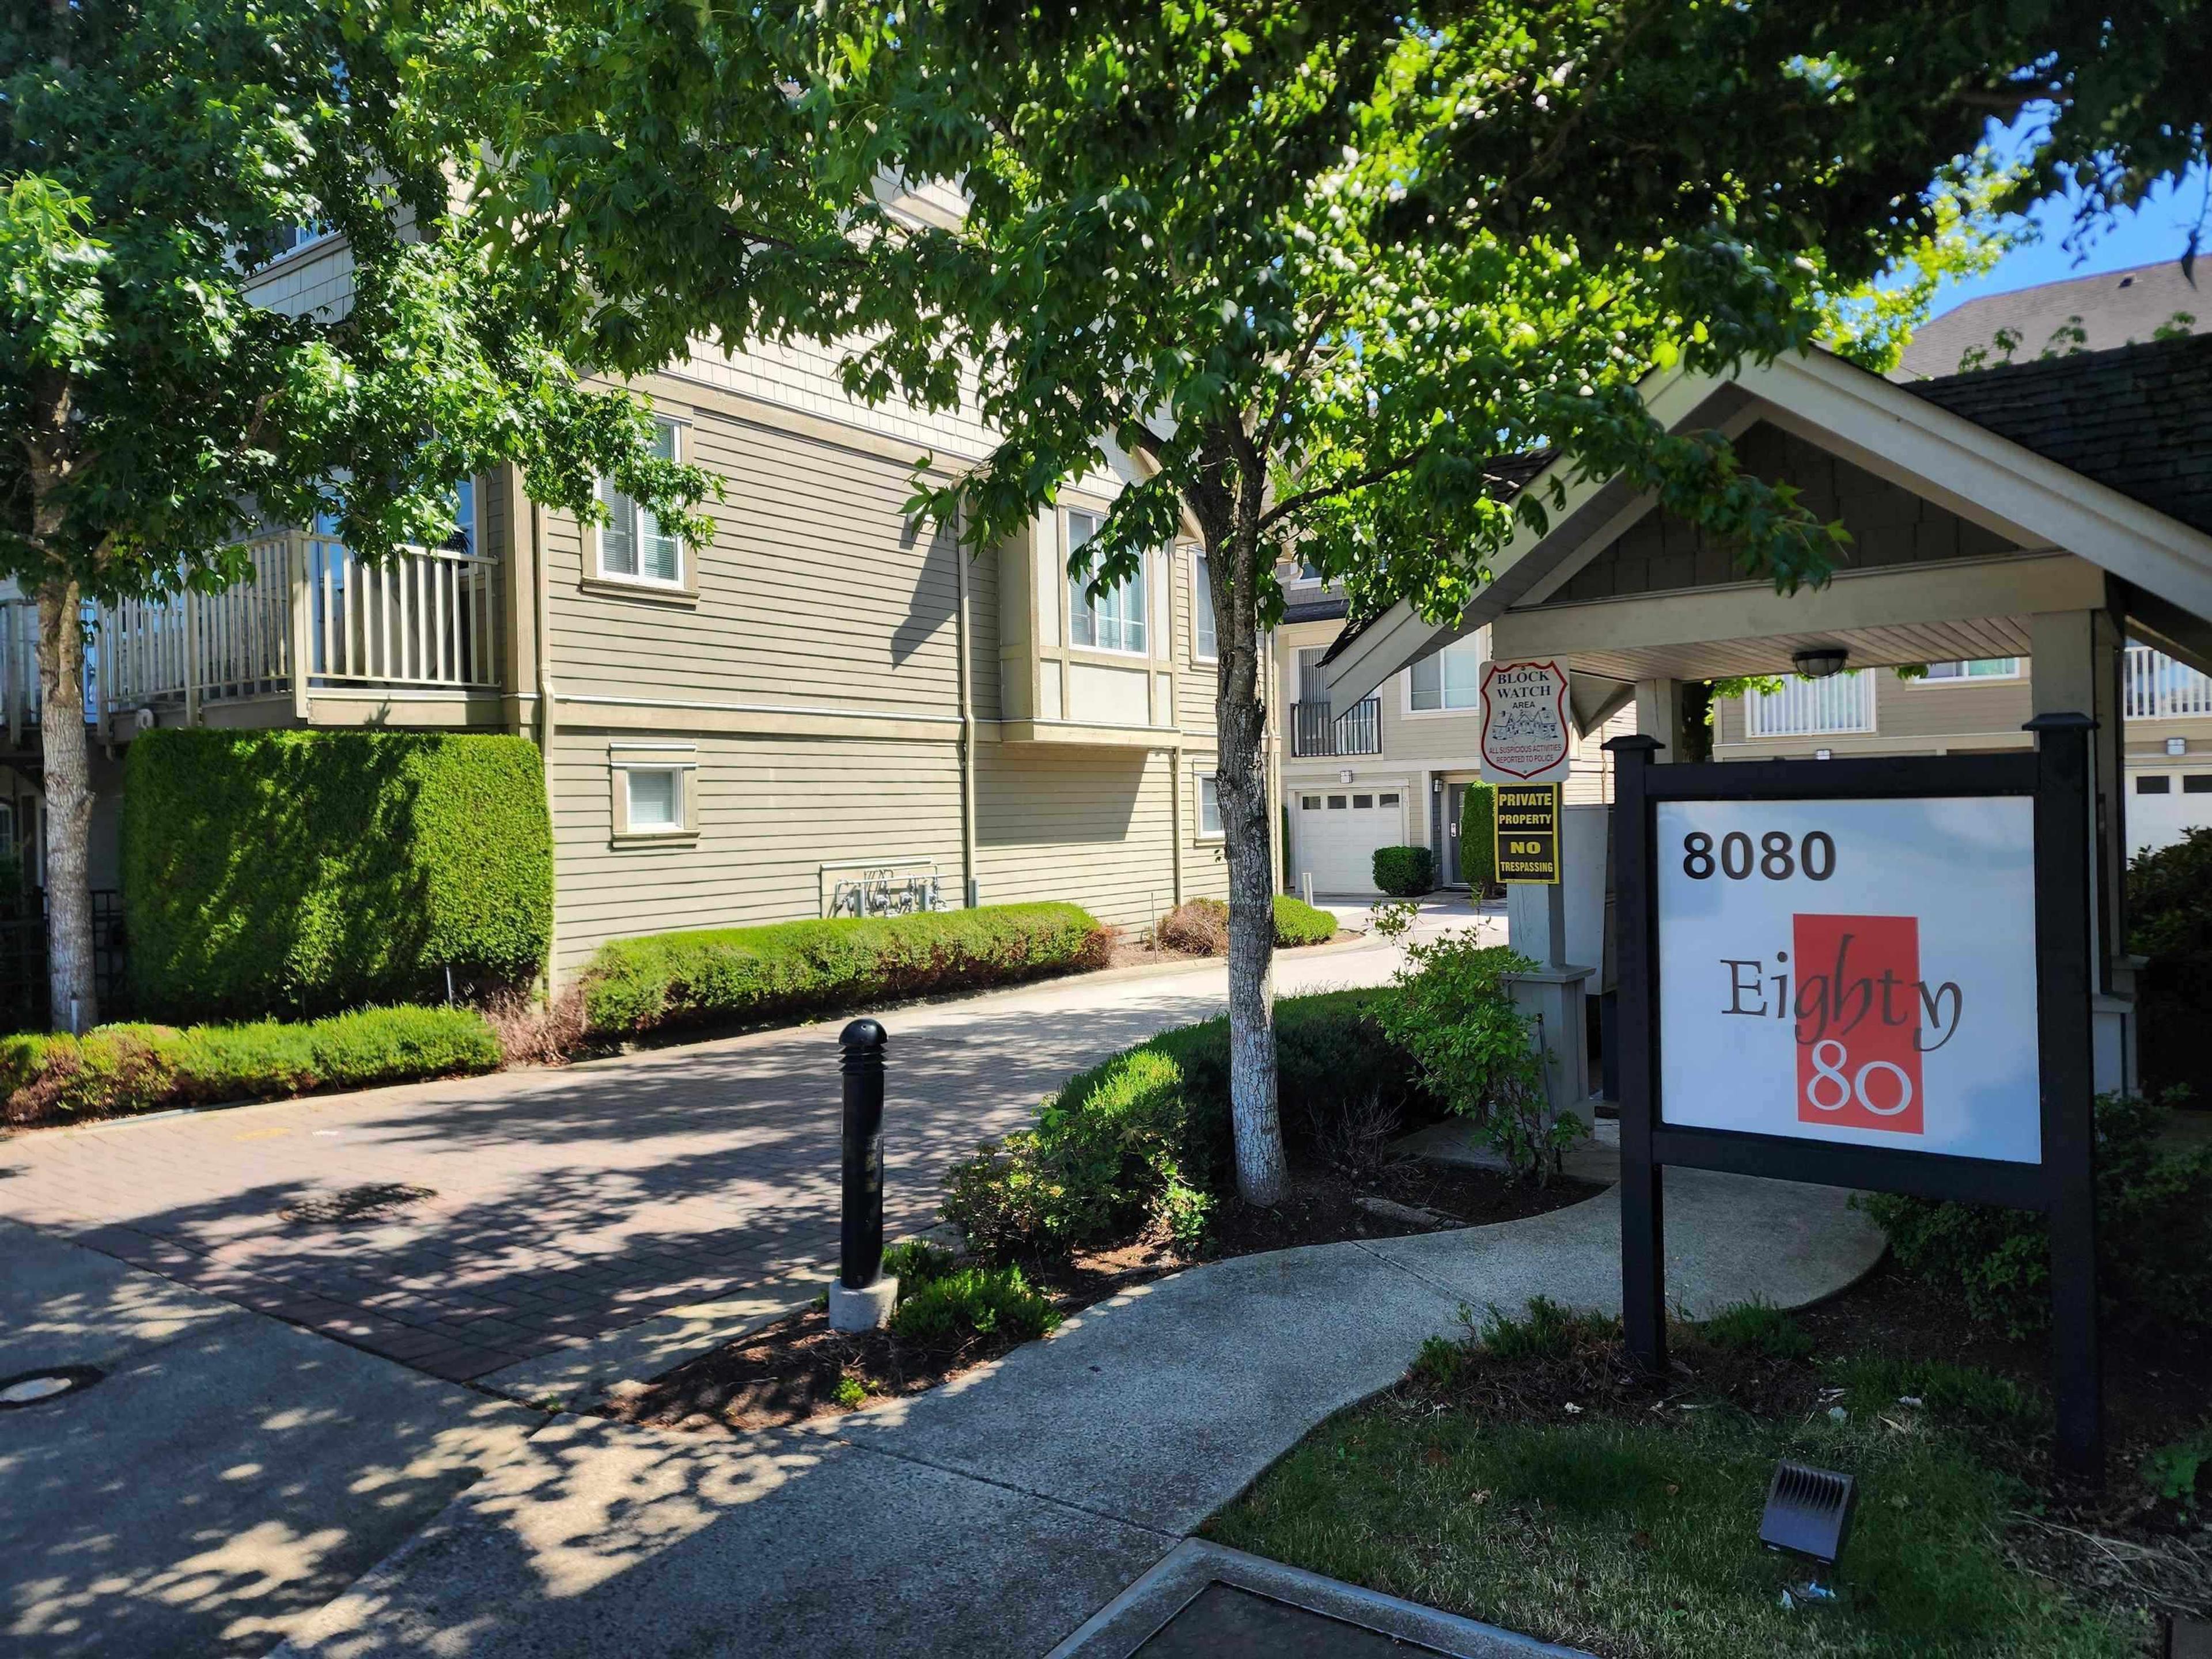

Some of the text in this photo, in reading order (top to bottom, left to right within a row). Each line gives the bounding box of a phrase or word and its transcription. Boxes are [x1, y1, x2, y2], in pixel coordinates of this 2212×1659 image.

[1498, 671, 1550, 685] BLOCK
[1497, 685, 1551, 699] WATCH
[1512, 701, 1535, 709] AREA
[1533, 744, 1562, 752] ACTIVITIES
[1497, 755, 1525, 763] REPORTED
[1534, 755, 1554, 763] POLICE
[1499, 793, 1552, 806] PRIVATE
[1499, 814, 1552, 824] PROPERTY
[1510, 842, 1541, 854] NO
[1683, 831, 1836, 881] 8080
[1500, 862, 1554, 872] TRESPASSING
[1720, 934, 1963, 1052] Eighty
[1806, 1040, 1913, 1116] 80
